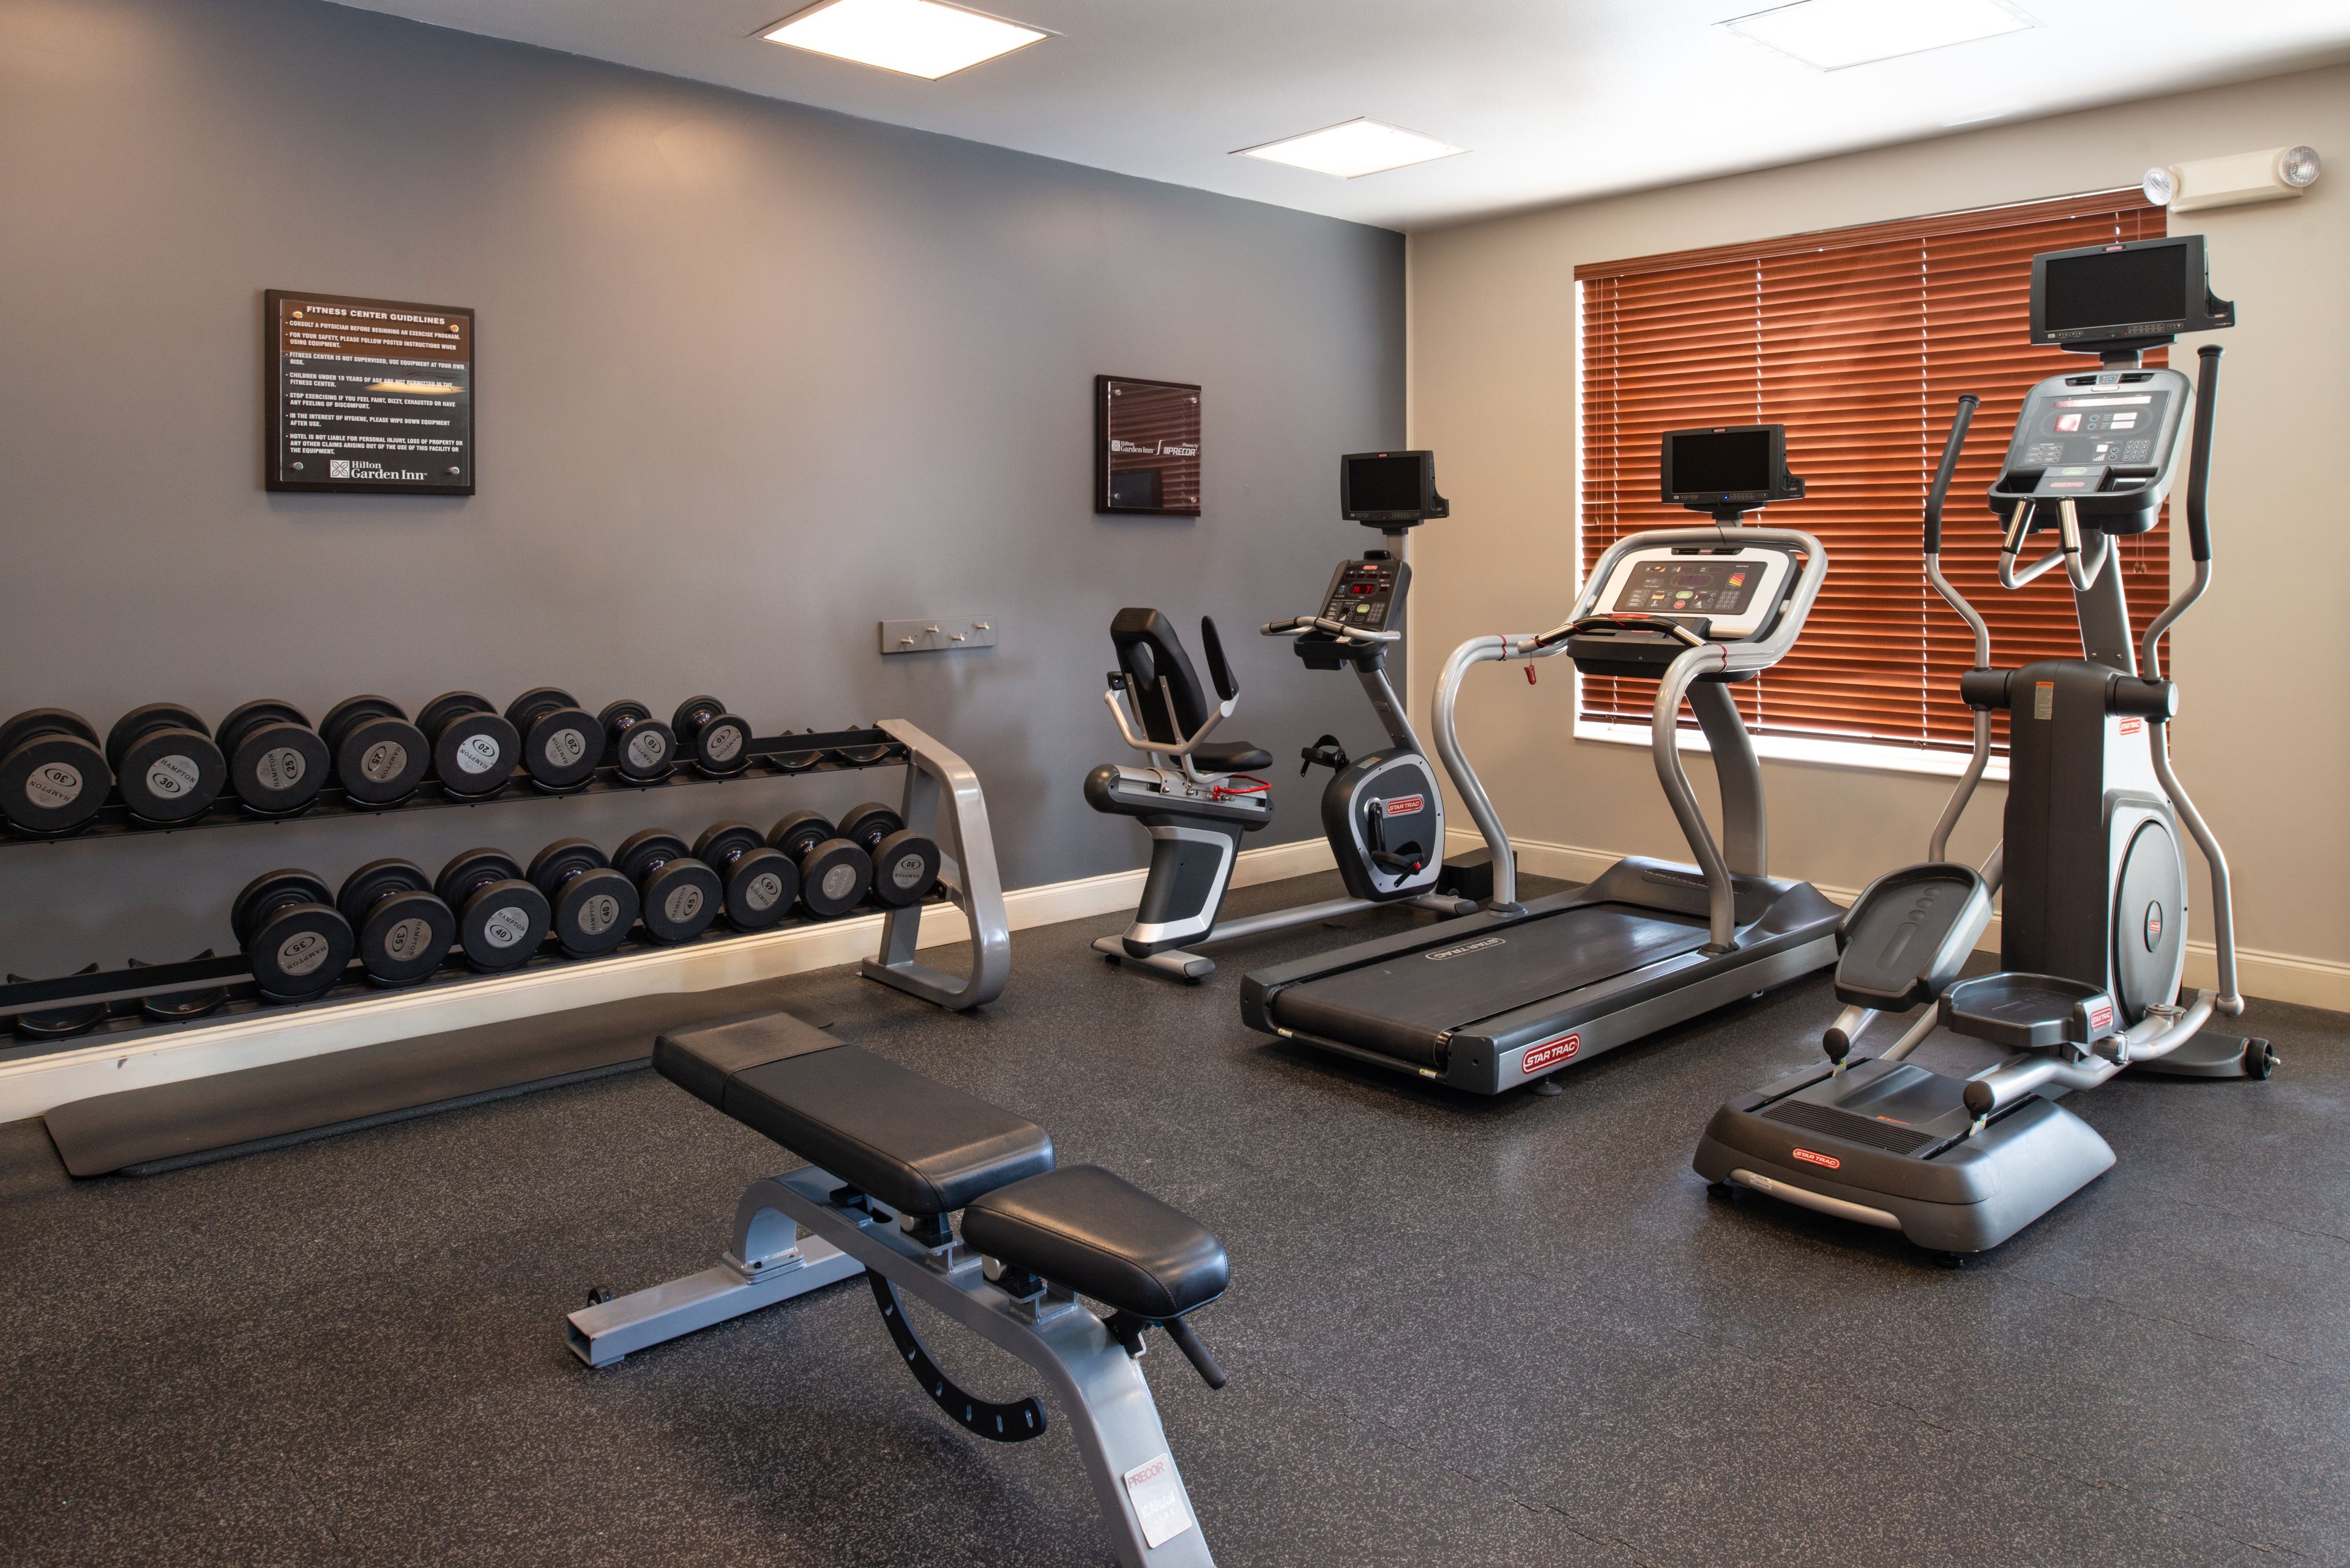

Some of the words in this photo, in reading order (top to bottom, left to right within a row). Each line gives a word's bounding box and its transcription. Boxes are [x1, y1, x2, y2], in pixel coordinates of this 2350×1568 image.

[307, 306, 347, 316] FITNESS
[350, 310, 387, 319] CENTER
[390, 314, 446, 325] GUIDELINES
[1164, 447, 1196, 456] PRECOR
[351, 468, 400, 479] Garden
[568, 739, 577, 749] 20
[648, 740, 657, 749] 10
[716, 734, 725, 744] 10
[479, 744, 490, 753] 20
[552, 737, 569, 765] HAMPTON
[632, 742, 654, 764] HAMPTON
[372, 753, 382, 764] 25
[381, 746, 402, 779] HAMPTON
[460, 749, 488, 769] HAMPTON
[161, 759, 196, 783] HAMPTON
[268, 753, 280, 788] HAMPTON
[286, 761, 294, 772] 25
[53, 772, 68, 783] 30
[160, 777, 173, 788] 30
[29, 781, 71, 802] HAMPTON
[765, 881, 774, 890] 45
[671, 887, 686, 918] HAMPTON
[687, 899, 695, 909] 45
[603, 906, 610, 916] 40
[497, 911, 526, 931] HAMPTON
[395, 933, 405, 944] 35
[409, 921, 423, 955] HAMPTON
[496, 929, 507, 938] 40
[293, 941, 307, 952] 35
[1467, 939, 1499, 949] STAR
[287, 946, 327, 970] HAMPTON
[1434, 947, 1469, 958] TRAC
[1526, 1050, 1551, 1066] STAR
[1551, 1041, 1576, 1058] TRAC
[1795, 1151, 1815, 1160] STAR
[1816, 1157, 1836, 1165] TRAC
[1127, 1462, 1166, 1489] PRECOR
